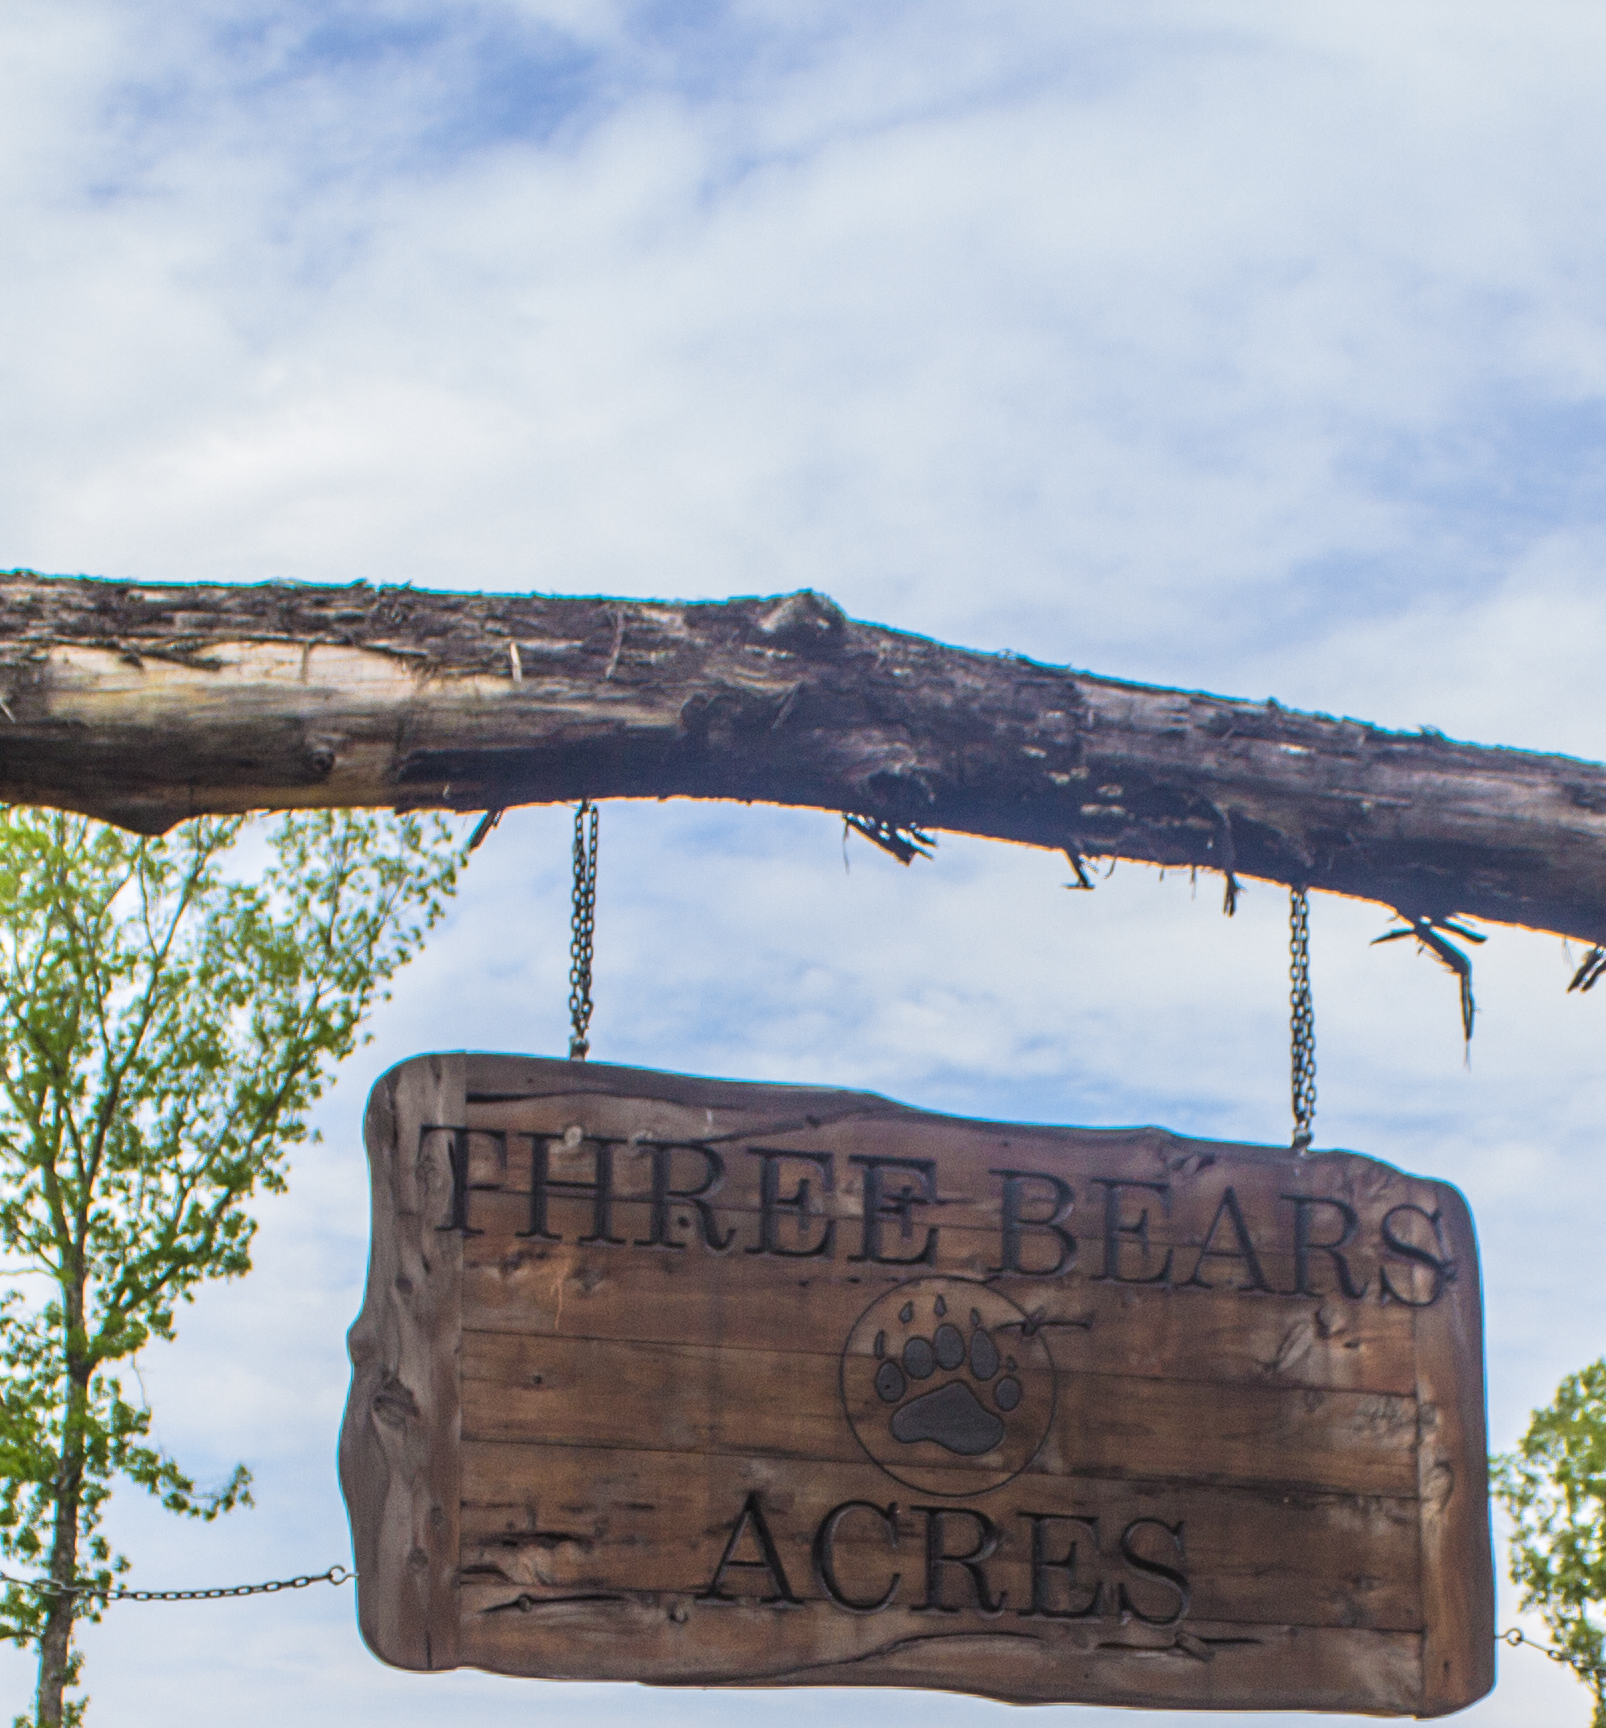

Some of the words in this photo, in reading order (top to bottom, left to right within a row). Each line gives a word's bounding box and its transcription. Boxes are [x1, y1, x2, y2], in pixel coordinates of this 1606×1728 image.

[421, 1122, 941, 1268] THREE
[985, 1166, 1460, 1308] BEARS
[701, 1491, 1191, 1626] ACRES
